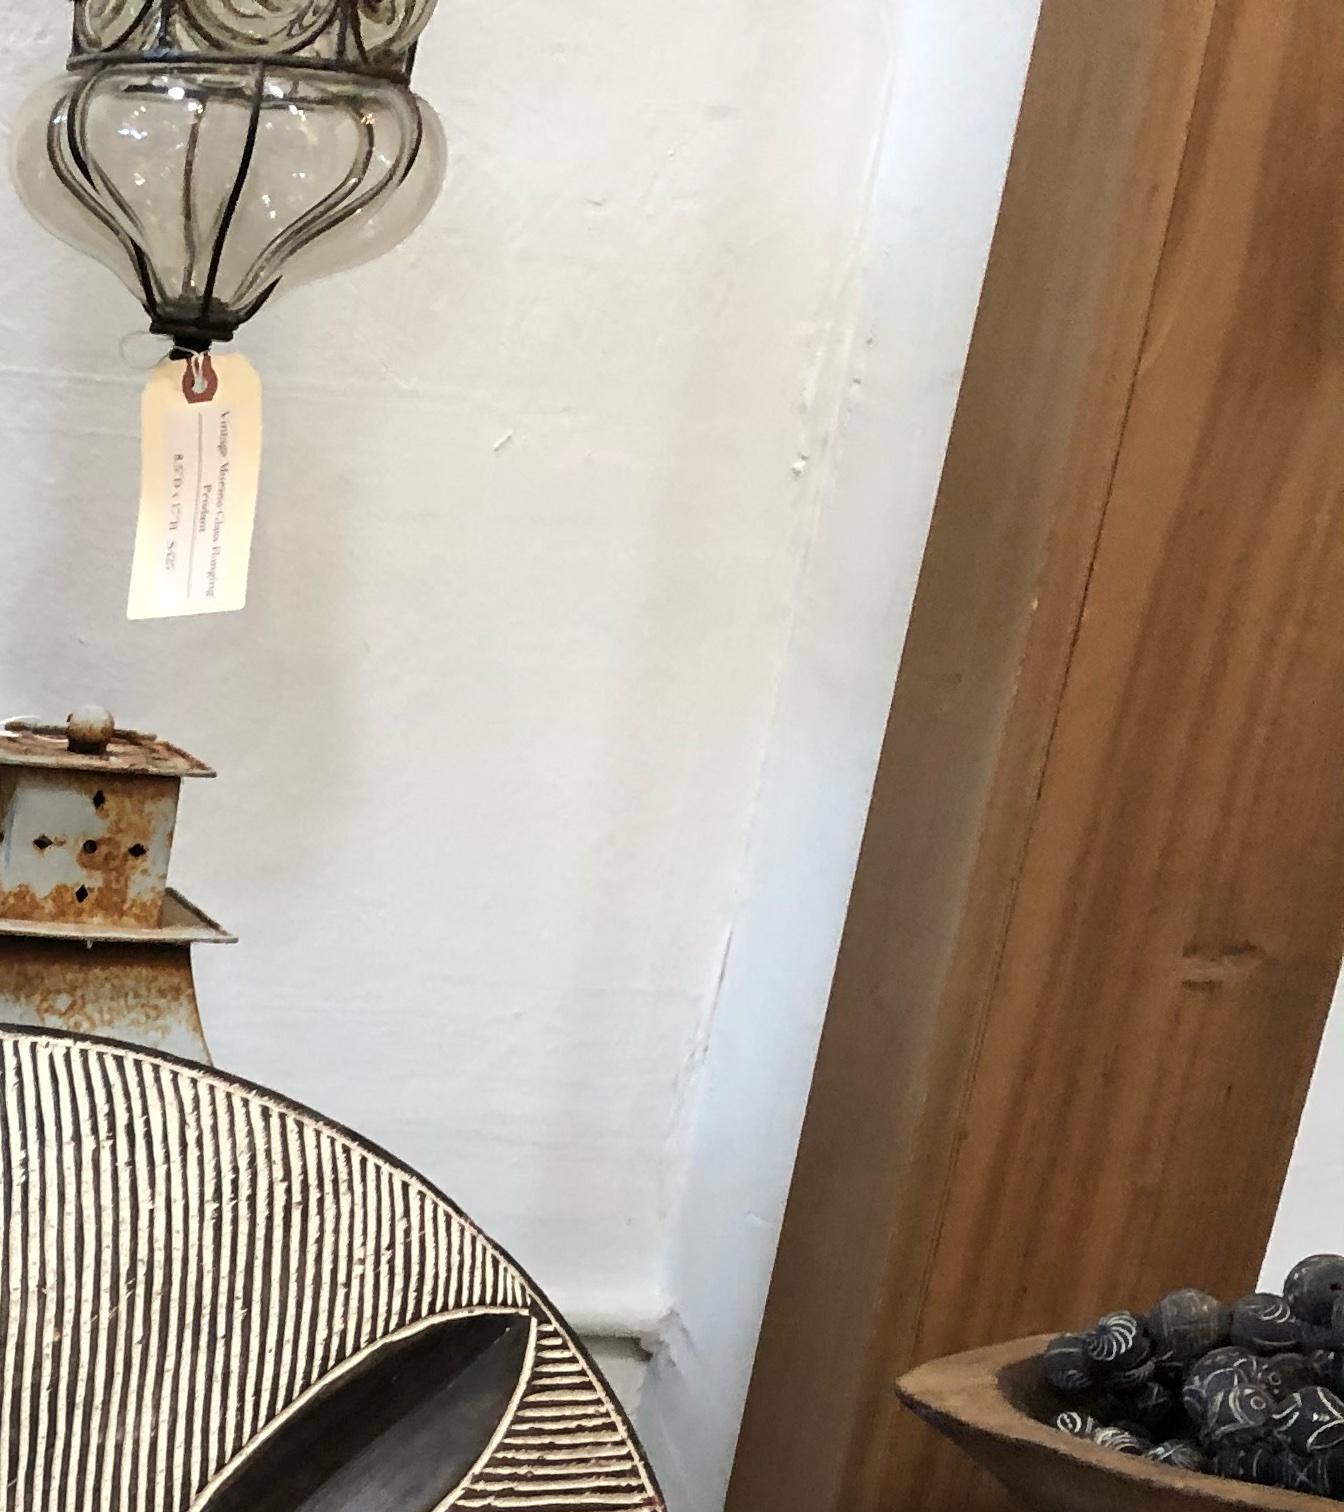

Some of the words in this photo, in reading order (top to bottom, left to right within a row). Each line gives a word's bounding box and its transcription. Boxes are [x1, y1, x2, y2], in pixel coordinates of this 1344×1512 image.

[218, 410, 230, 458] Vintage
[199, 484, 212, 532] Pendant
[206, 544, 220, 597] Hanging
